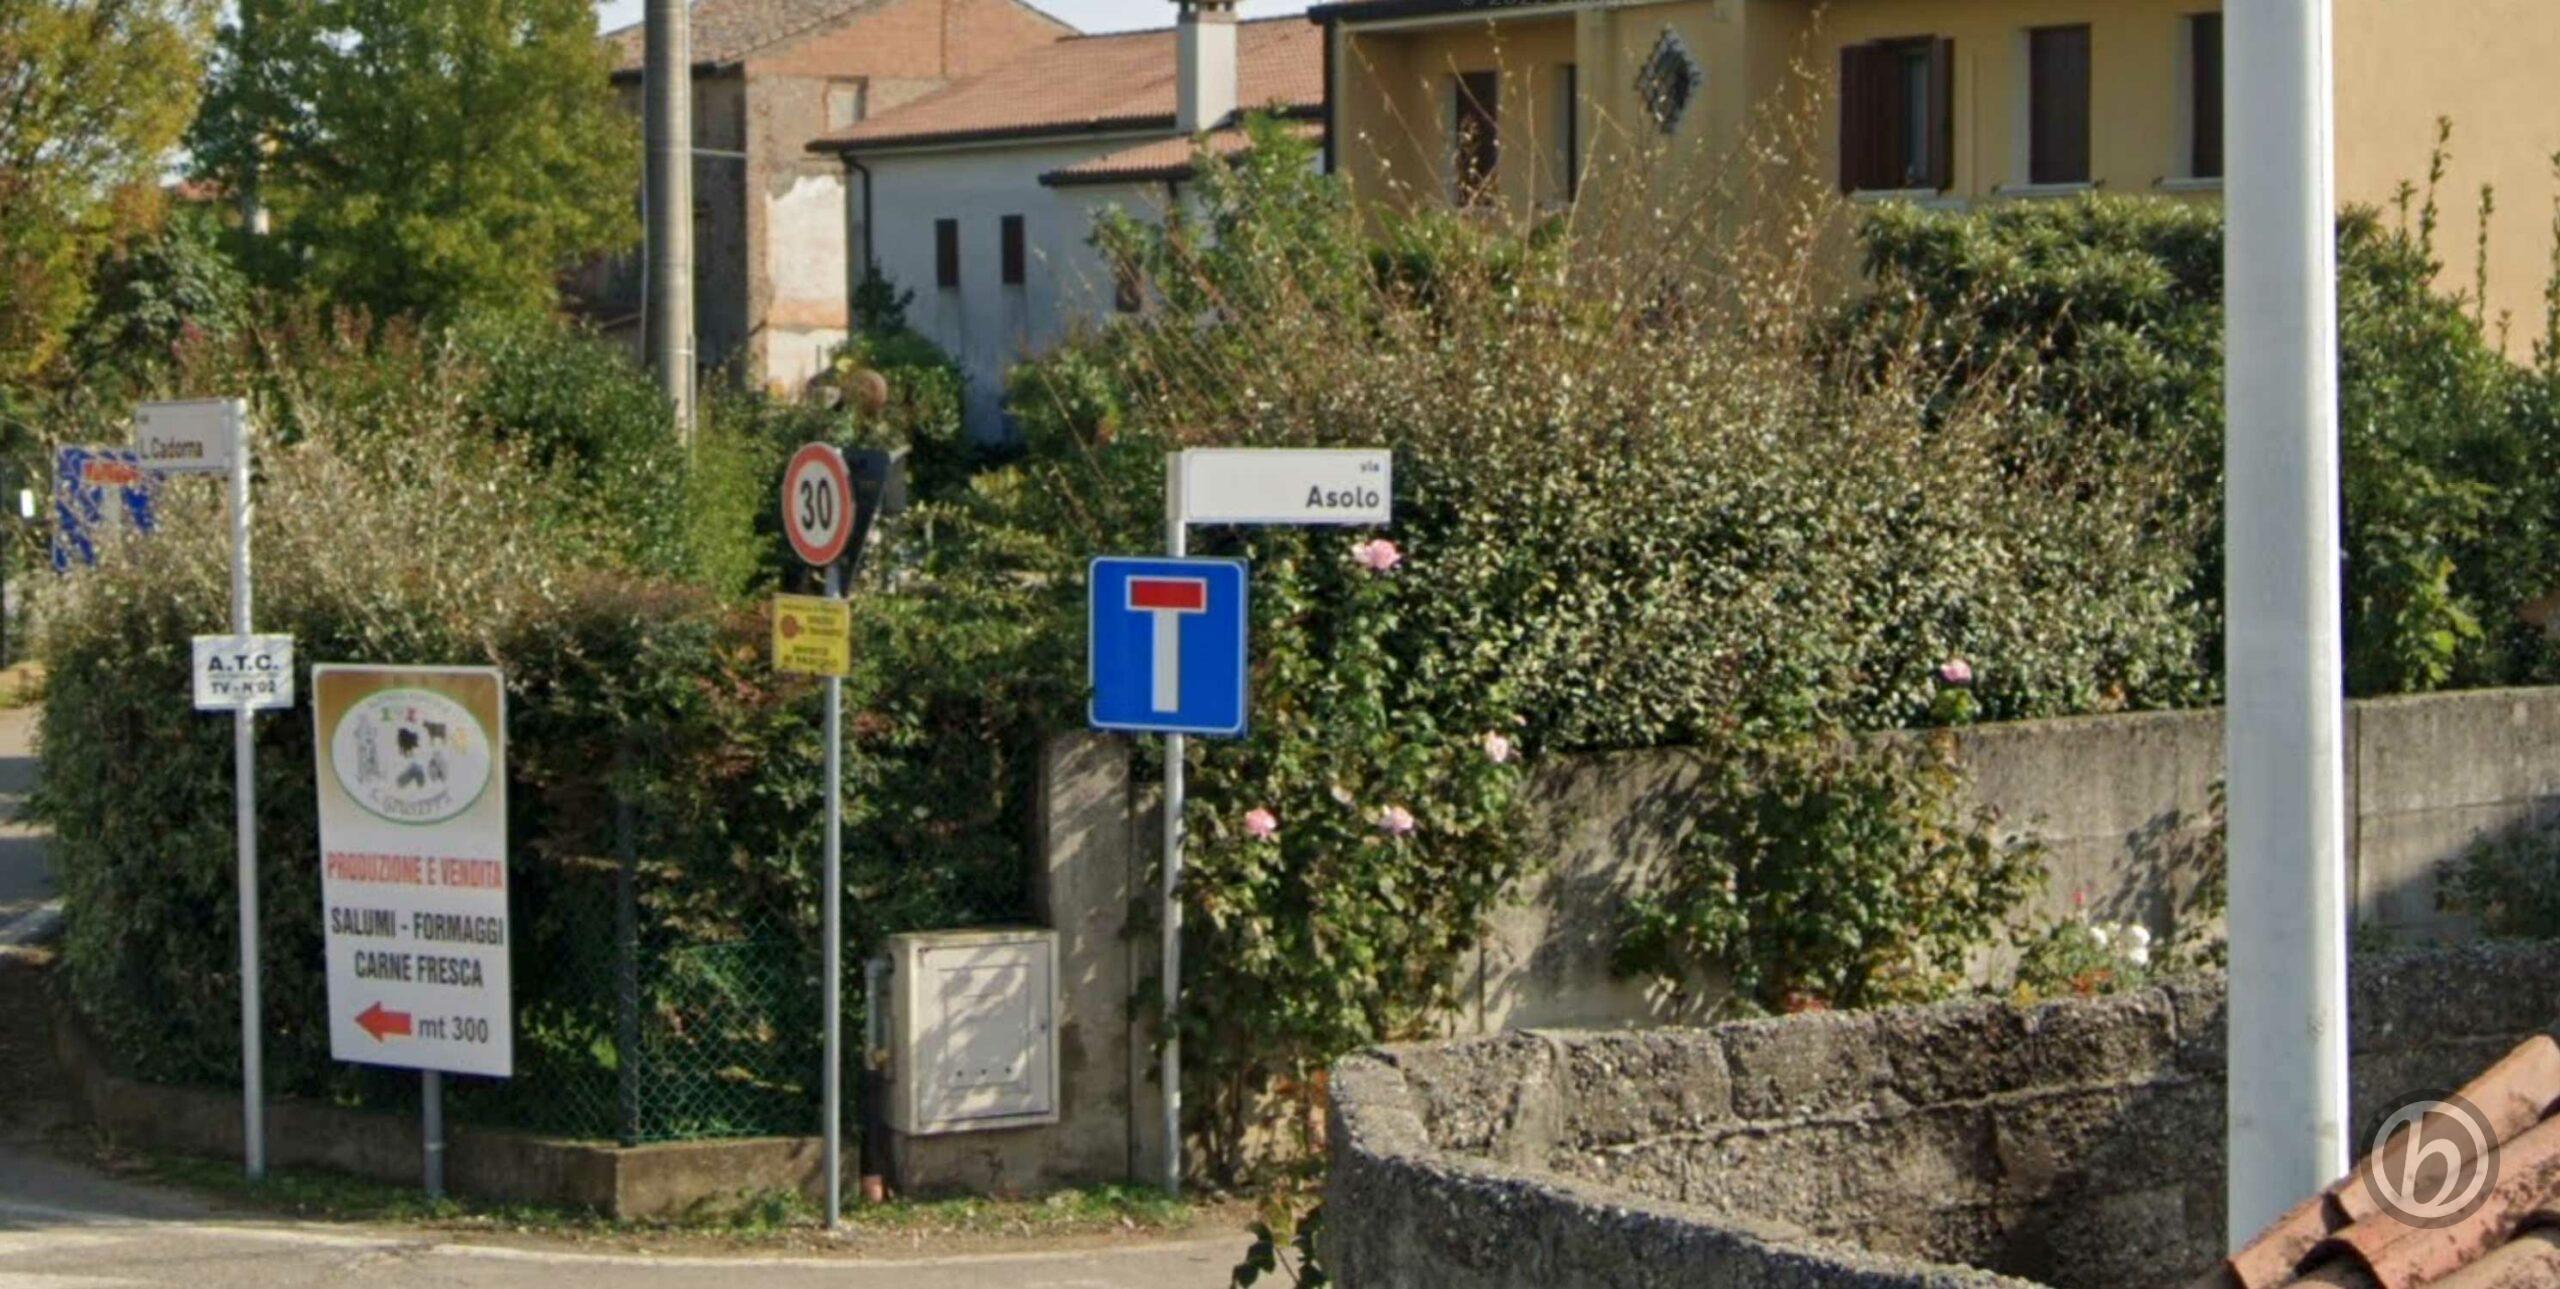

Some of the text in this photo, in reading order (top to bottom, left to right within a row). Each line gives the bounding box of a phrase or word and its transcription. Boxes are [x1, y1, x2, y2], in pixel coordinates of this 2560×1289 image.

[801, 479, 831, 530] 30
[1306, 486, 1380, 508] Asolo
[208, 655, 279, 671] A.T.C.
[328, 853, 502, 889] PRODUZIONE E VENDITA
[331, 907, 395, 938] SALUMI
[413, 912, 504, 945] FORMAGGI
[355, 951, 484, 987] CARNE FRESCA
[418, 1016, 488, 1043] mt 300
